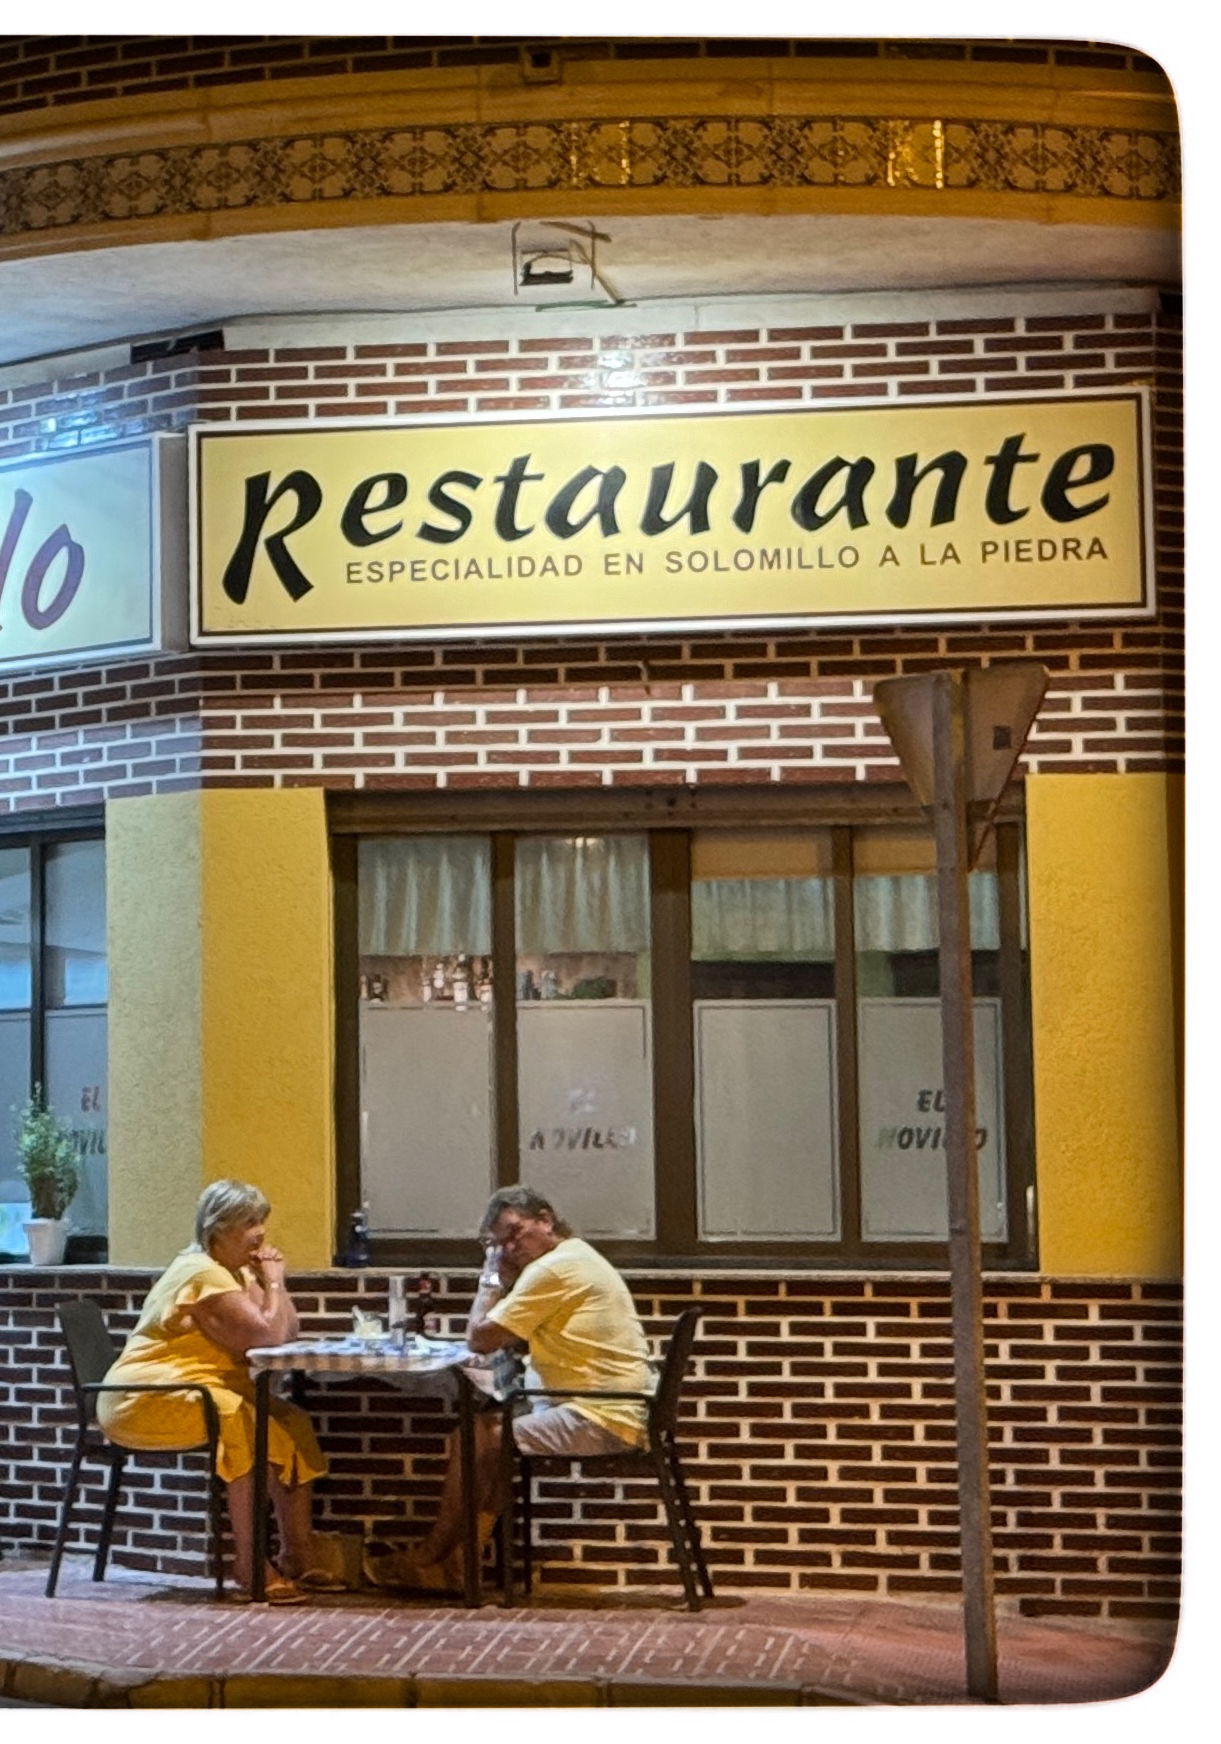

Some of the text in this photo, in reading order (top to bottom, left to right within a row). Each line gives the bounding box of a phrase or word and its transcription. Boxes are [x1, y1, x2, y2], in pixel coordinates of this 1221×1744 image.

[222, 432, 1116, 605] Restaurante
[346, 537, 1109, 586] ESPECIALIDAD EN SOLOMILLO A LA PIEDRA
